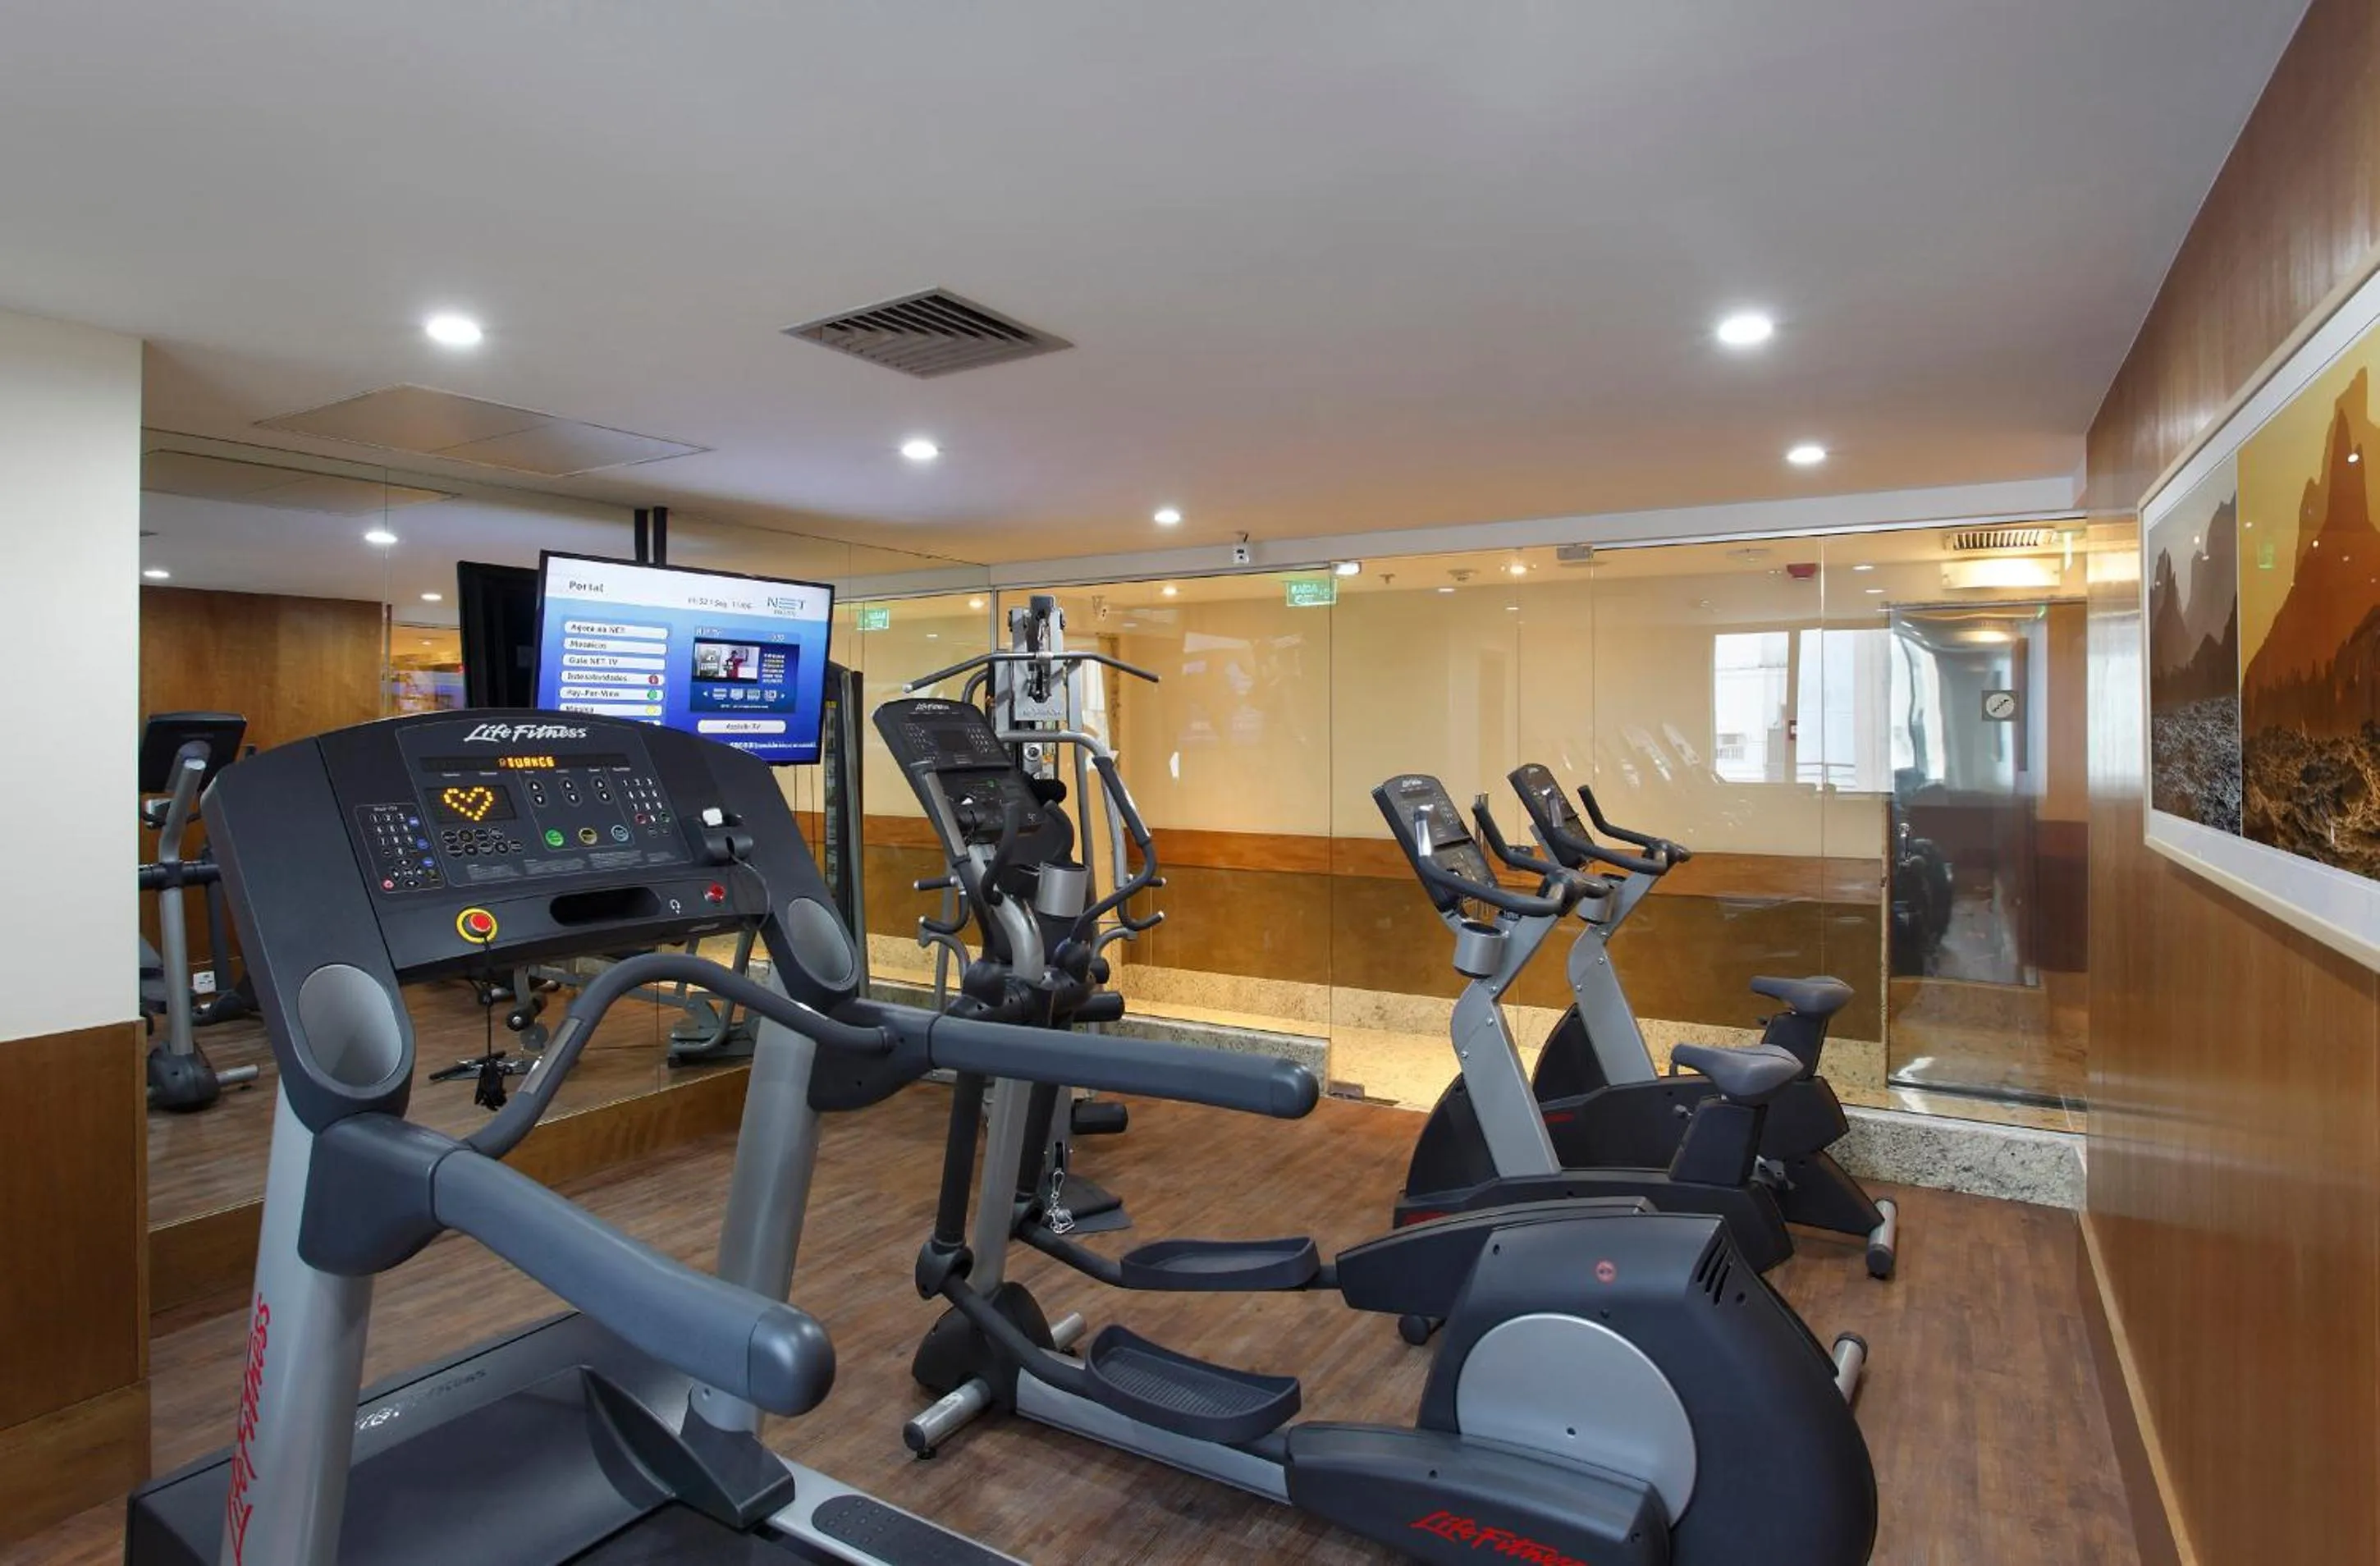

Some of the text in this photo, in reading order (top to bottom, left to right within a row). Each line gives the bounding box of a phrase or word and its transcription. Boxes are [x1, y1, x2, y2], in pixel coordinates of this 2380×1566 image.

[568, 579, 605, 593] Portal
[463, 723, 587, 743] Life Fitness
[1409, 1509, 1476, 1544] Life
